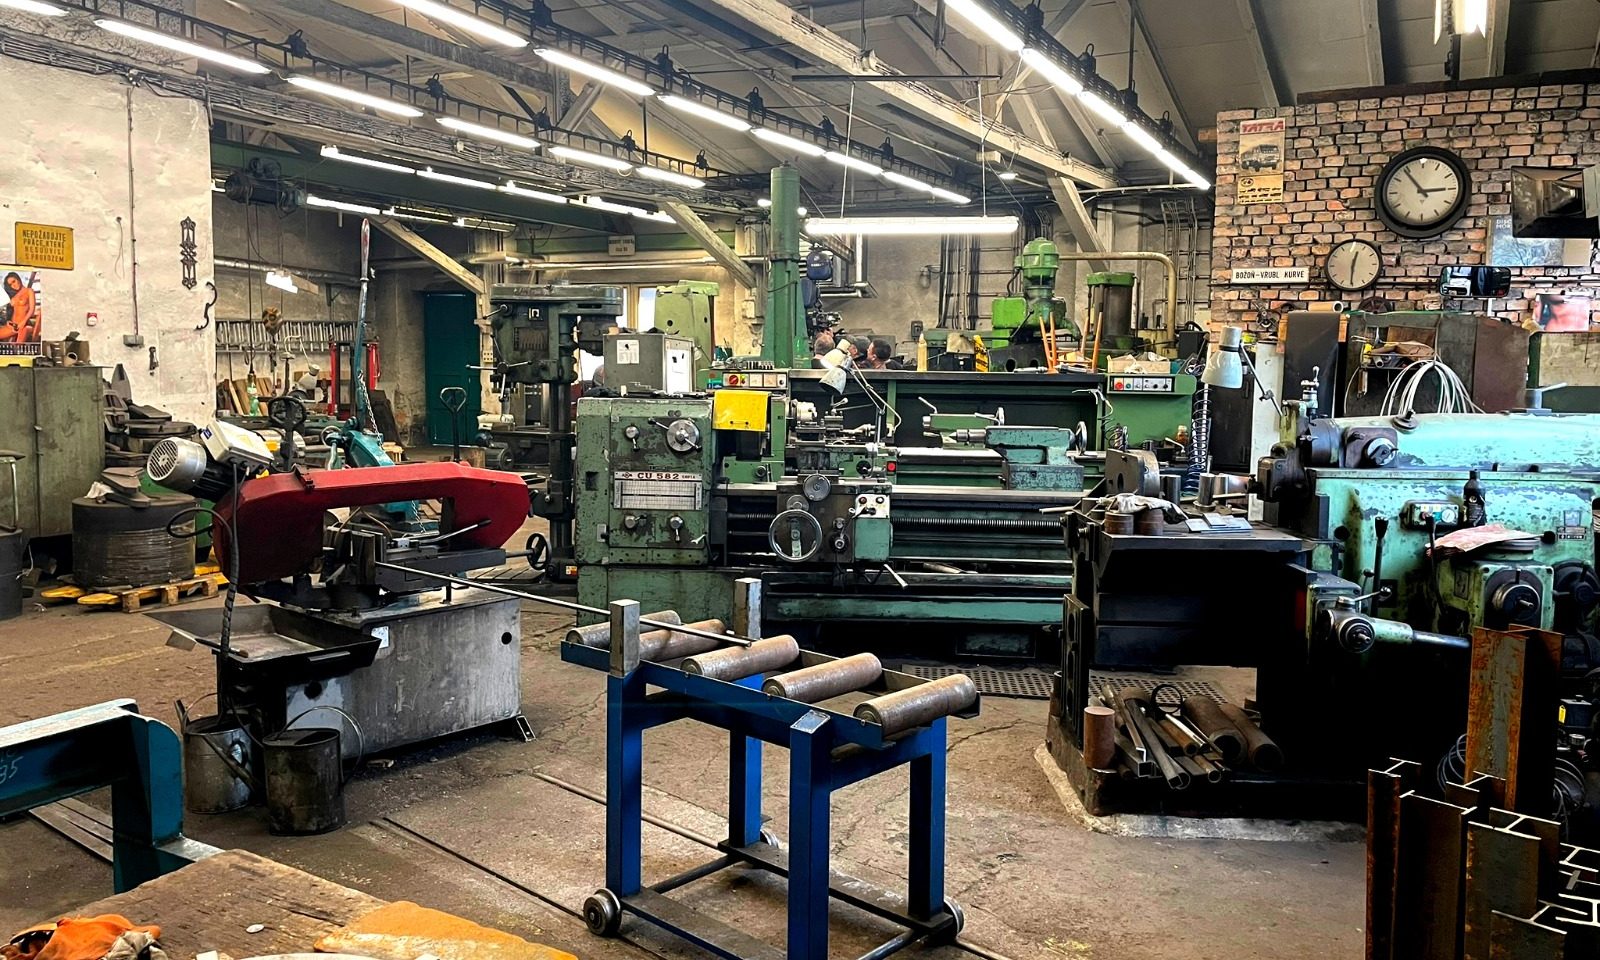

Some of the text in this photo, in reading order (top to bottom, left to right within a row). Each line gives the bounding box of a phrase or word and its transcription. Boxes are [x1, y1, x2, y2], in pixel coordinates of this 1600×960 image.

[1241, 121, 1284, 132] TATRA
[1284, 270, 1305, 279] KURVE
[637, 472, 653, 480] CU
[656, 472, 680, 480] 582
